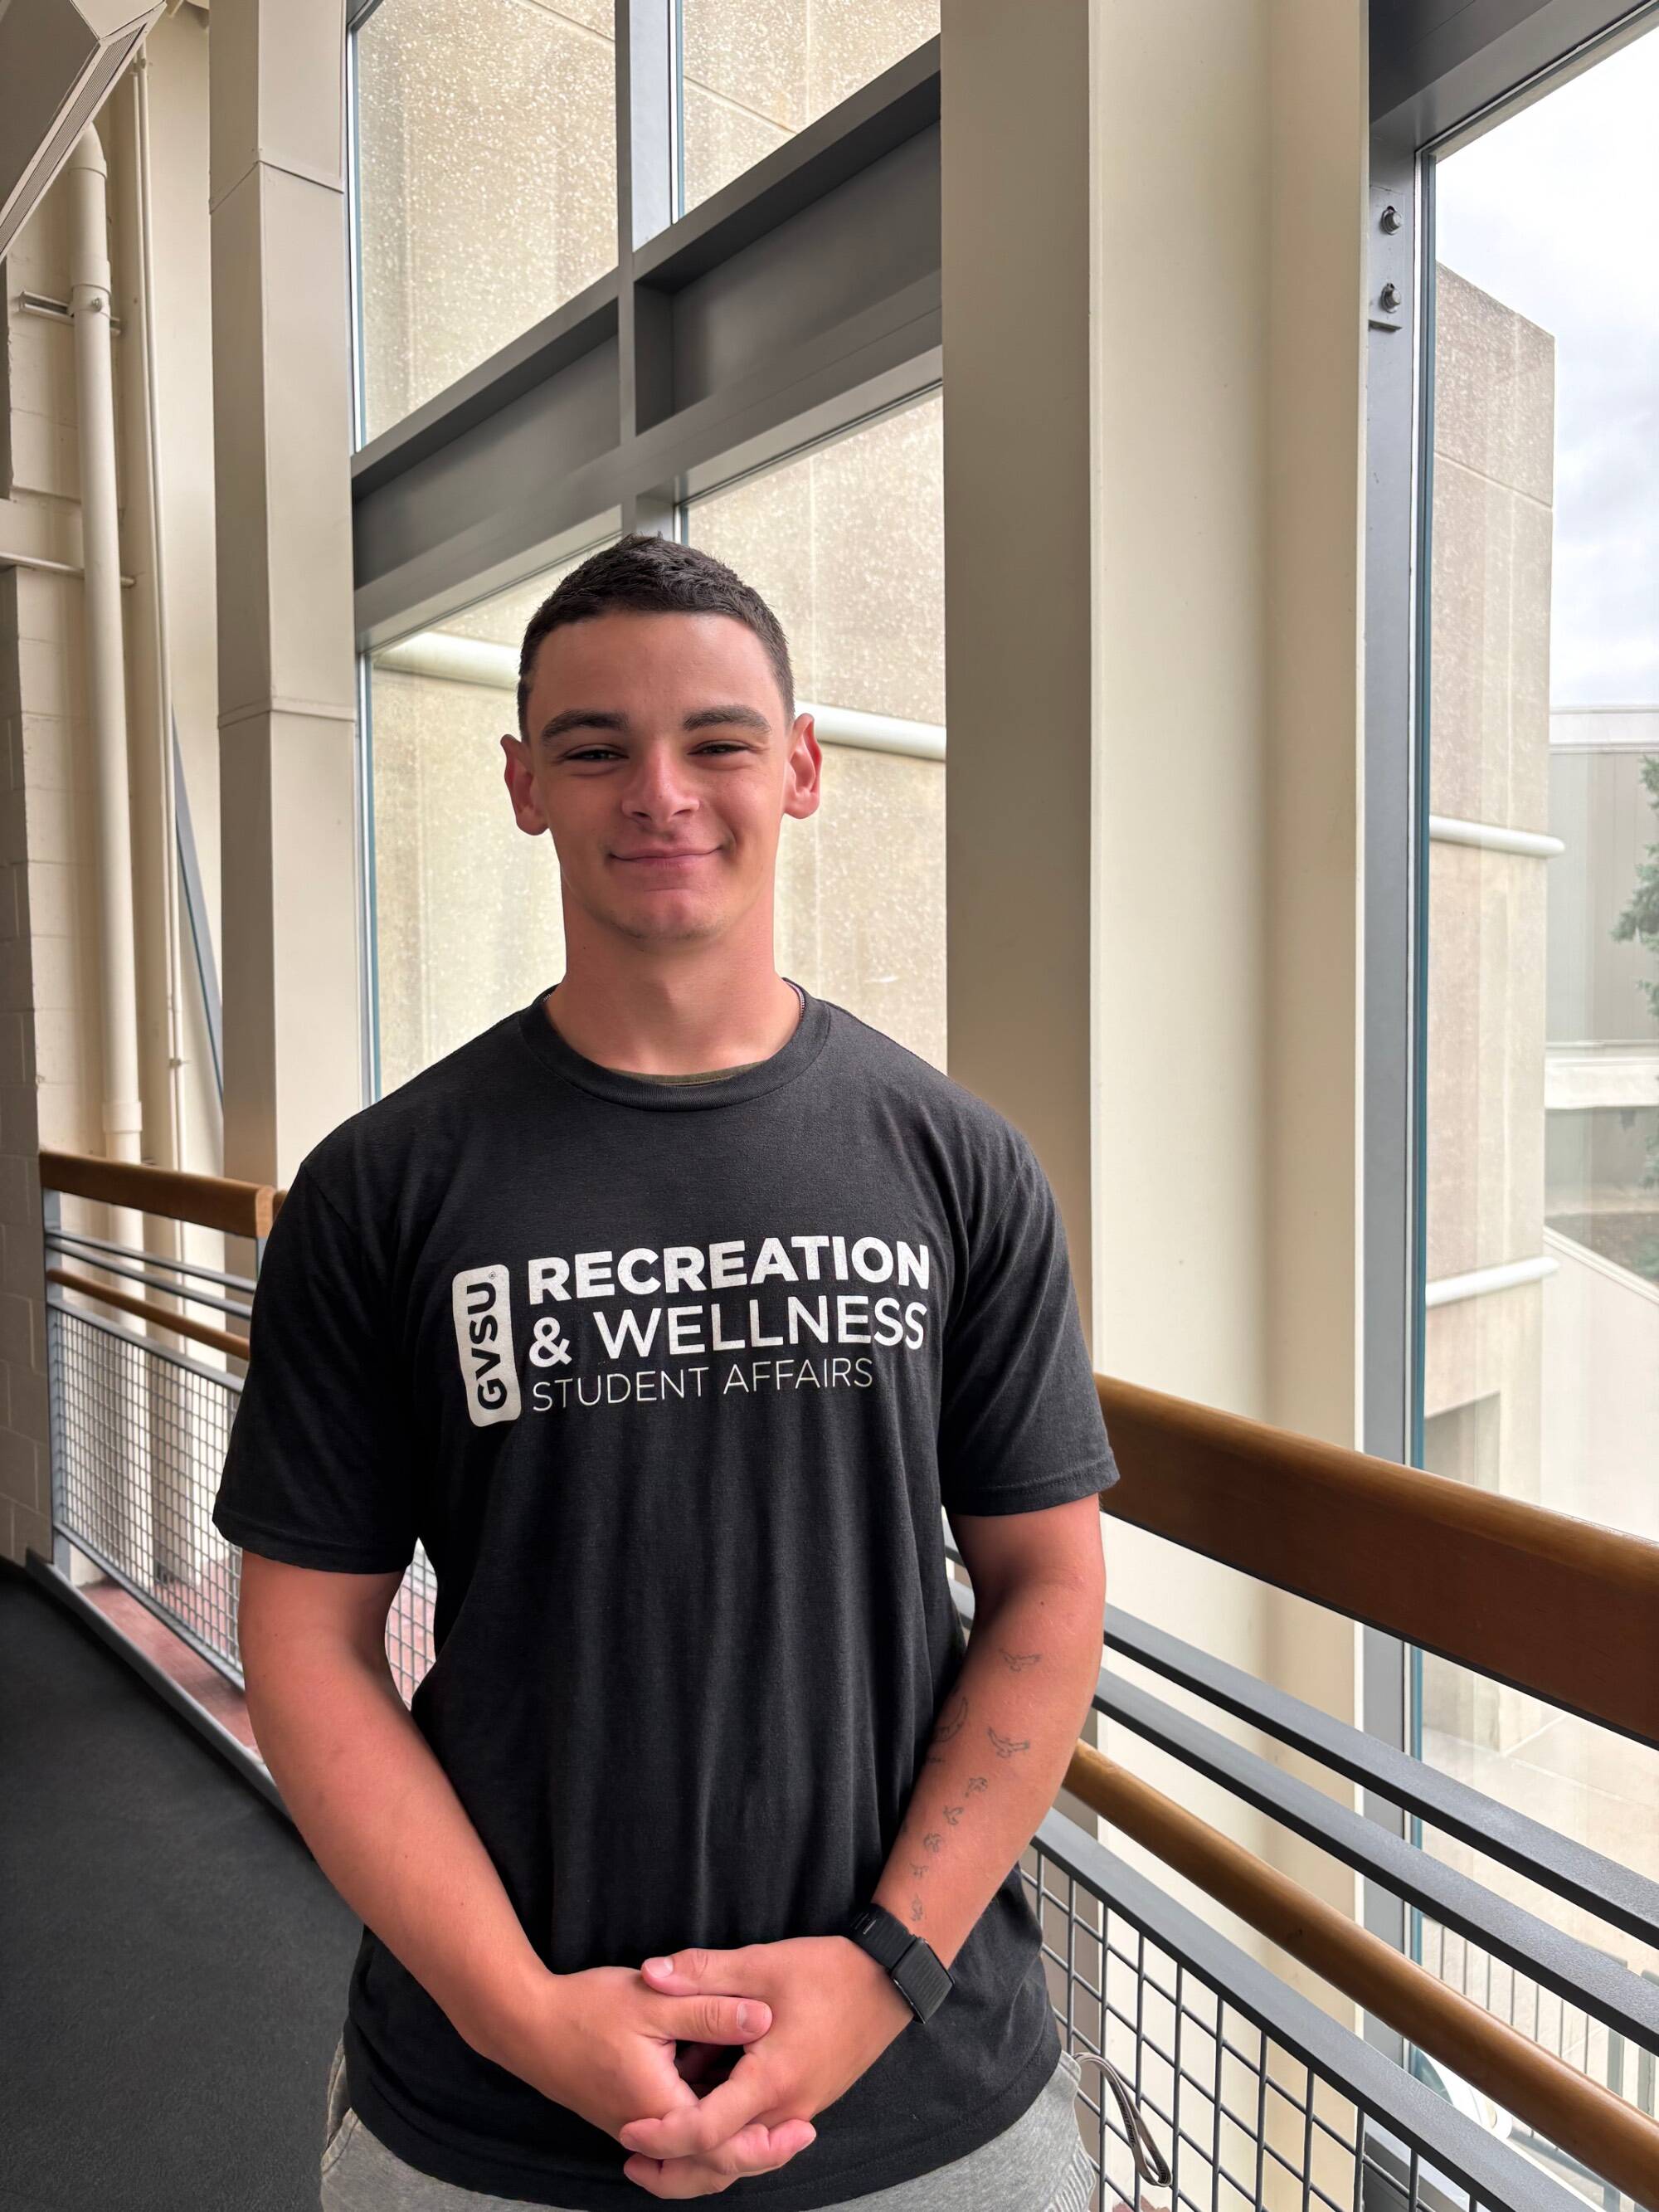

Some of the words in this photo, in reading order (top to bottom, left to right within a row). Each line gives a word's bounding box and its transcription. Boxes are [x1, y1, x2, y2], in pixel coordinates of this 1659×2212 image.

[528, 1235, 930, 1305] RECREATION
[466, 1281, 508, 1411] GVSU
[528, 1316, 572, 1368] &
[592, 1294, 928, 1360] WELLNESS
[533, 1367, 709, 1411] STUDENT
[722, 1357, 873, 1395] AFFAIRS
